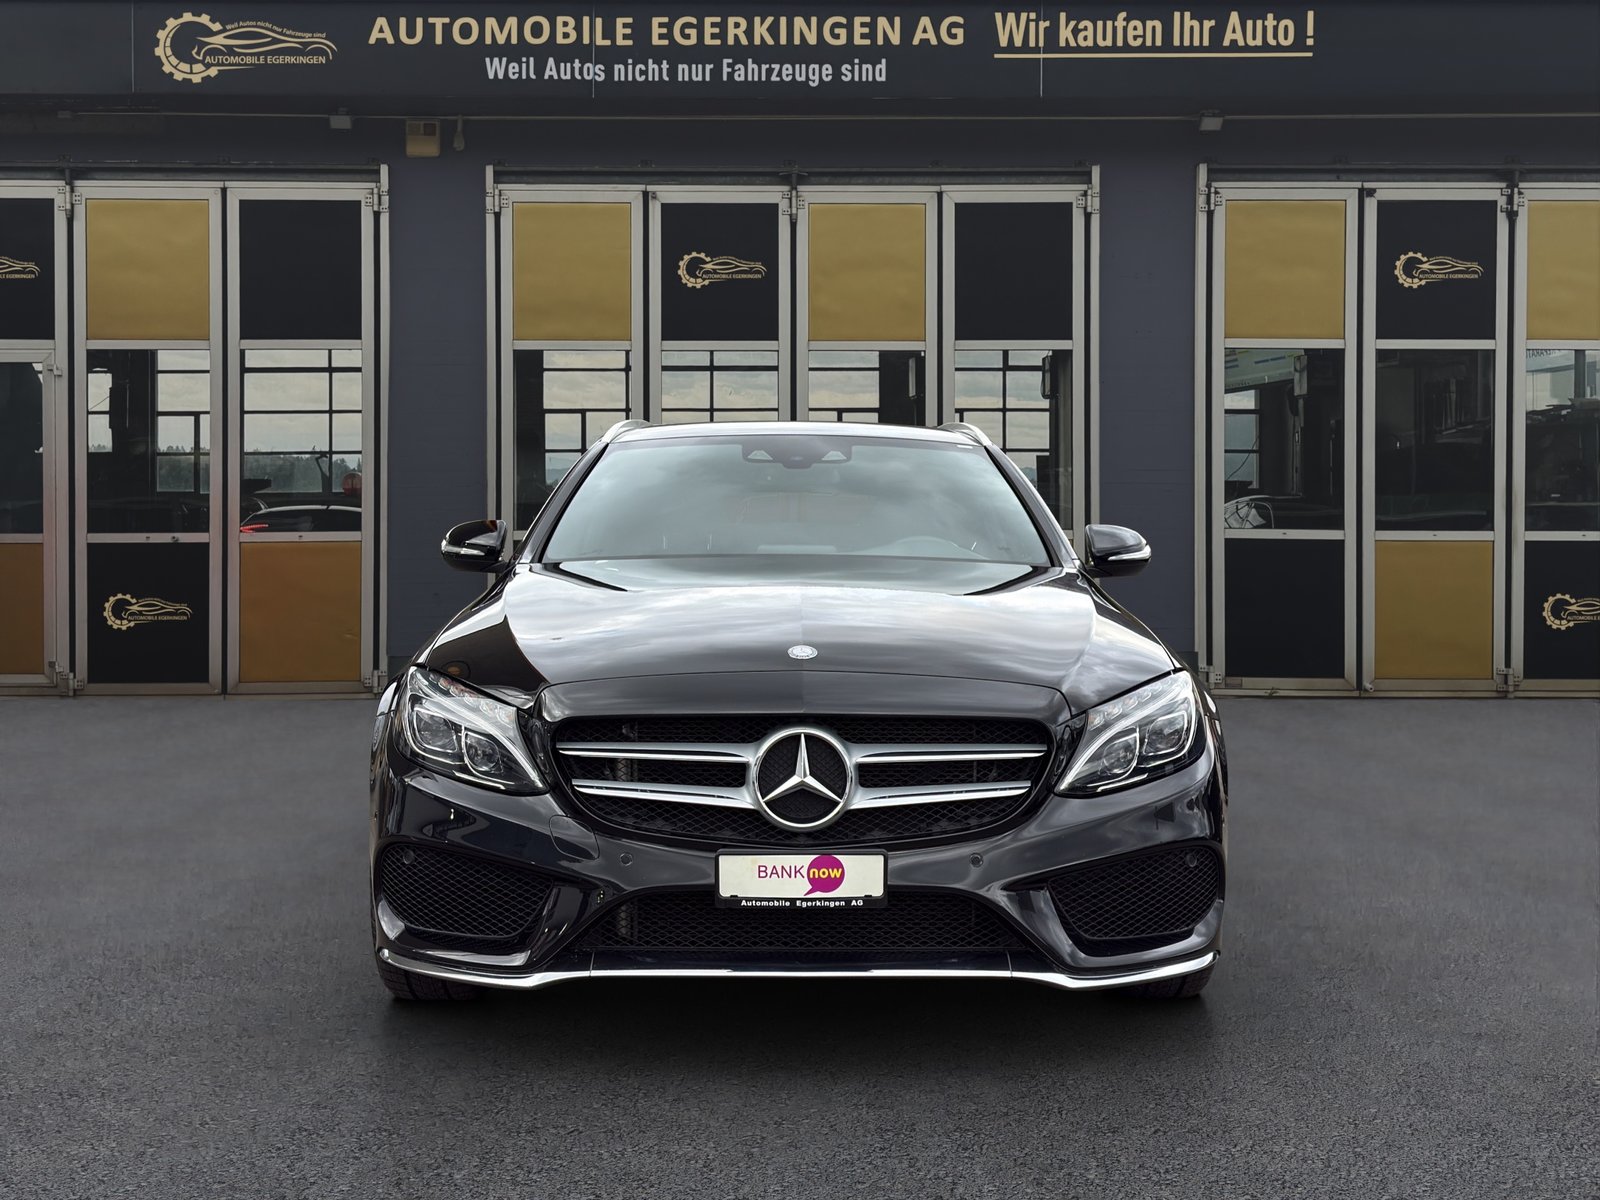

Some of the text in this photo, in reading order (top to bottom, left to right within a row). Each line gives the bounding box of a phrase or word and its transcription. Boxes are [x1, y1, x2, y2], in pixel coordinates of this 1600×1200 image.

[368, 15, 965, 46] AUTOMOBILE EGERKINGEN AG
[994, 10, 1315, 47] Wir kaufen Ihr Auto !
[204, 55, 326, 64] AUTOMOBILE EGERKINGEN
[485, 57, 887, 87] Weil Autos nicht nur Fahrzeuge sind
[757, 864, 843, 879] BANK now
[741, 899, 863, 908] Automobile Egerkingen AG
